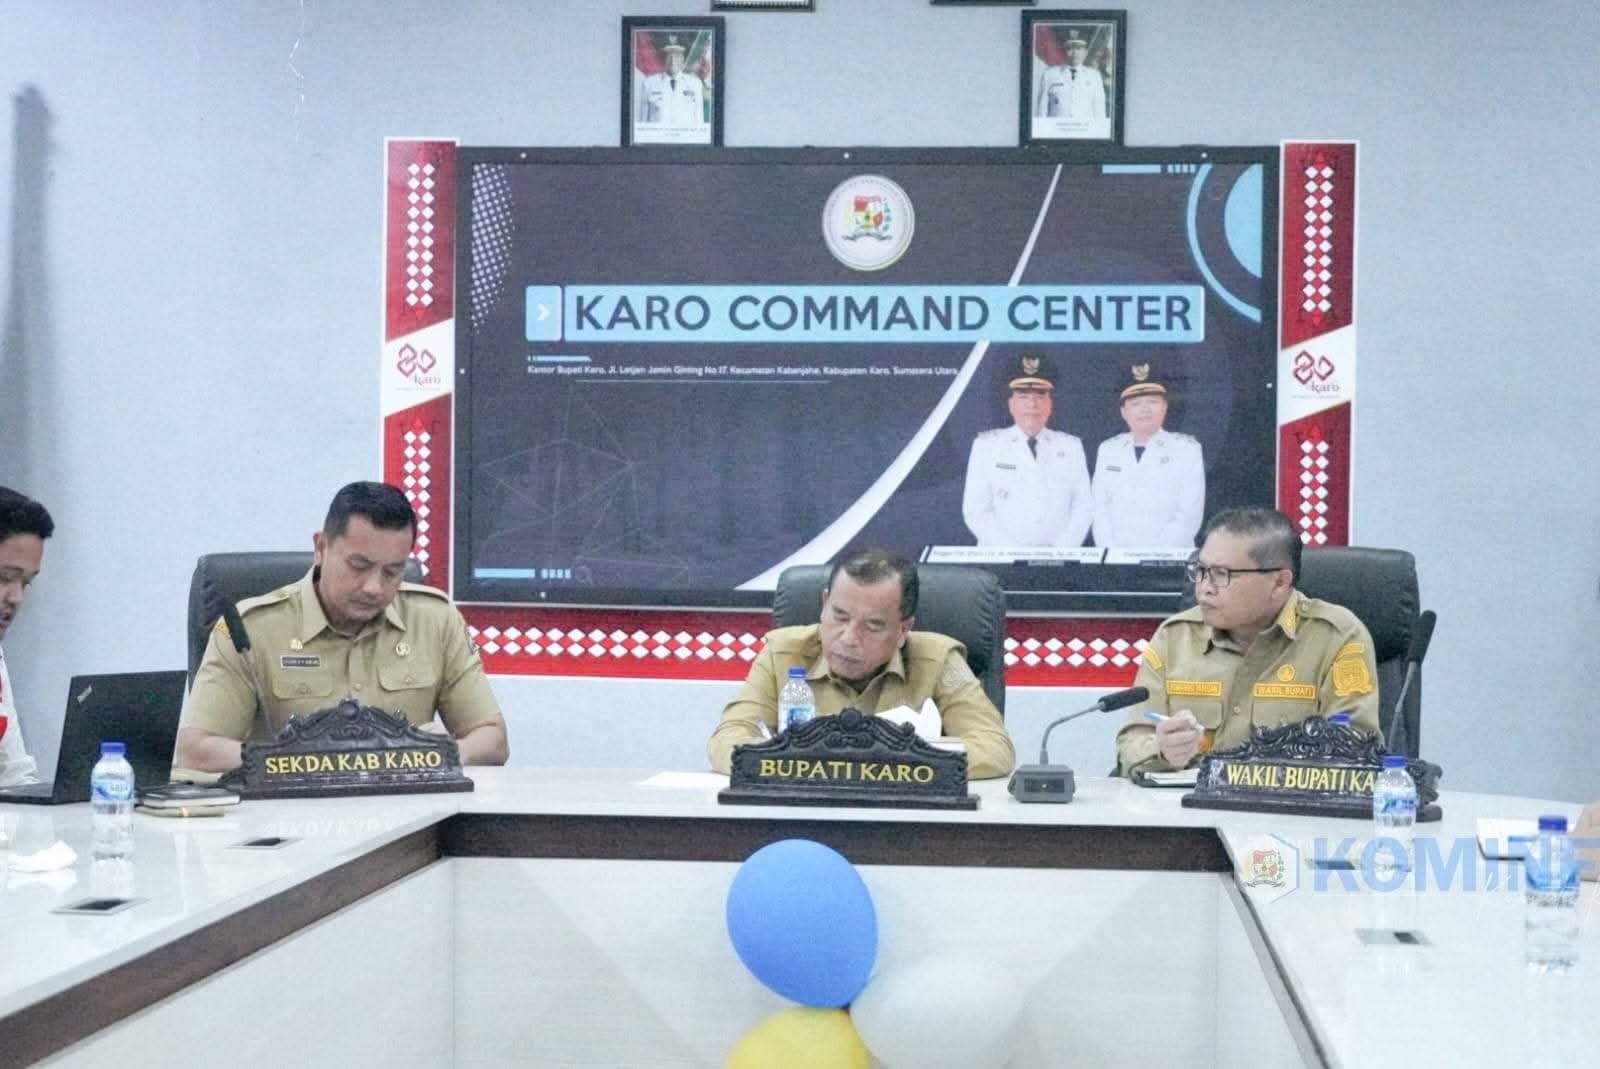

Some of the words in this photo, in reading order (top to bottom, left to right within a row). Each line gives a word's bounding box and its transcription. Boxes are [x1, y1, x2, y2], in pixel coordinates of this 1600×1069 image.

[576, 295, 711, 331] KARO
[729, 295, 989, 331] COMMAND
[1008, 295, 1192, 331] CENTER
[265, 755, 334, 774] SEKDA
[338, 752, 381, 771] KAB
[385, 750, 442, 769] KARO
[759, 759, 853, 780] BUPATI
[860, 763, 934, 783] KARO
[1226, 764, 1280, 787] WAKIL
[1283, 767, 1345, 791] BUPATI
